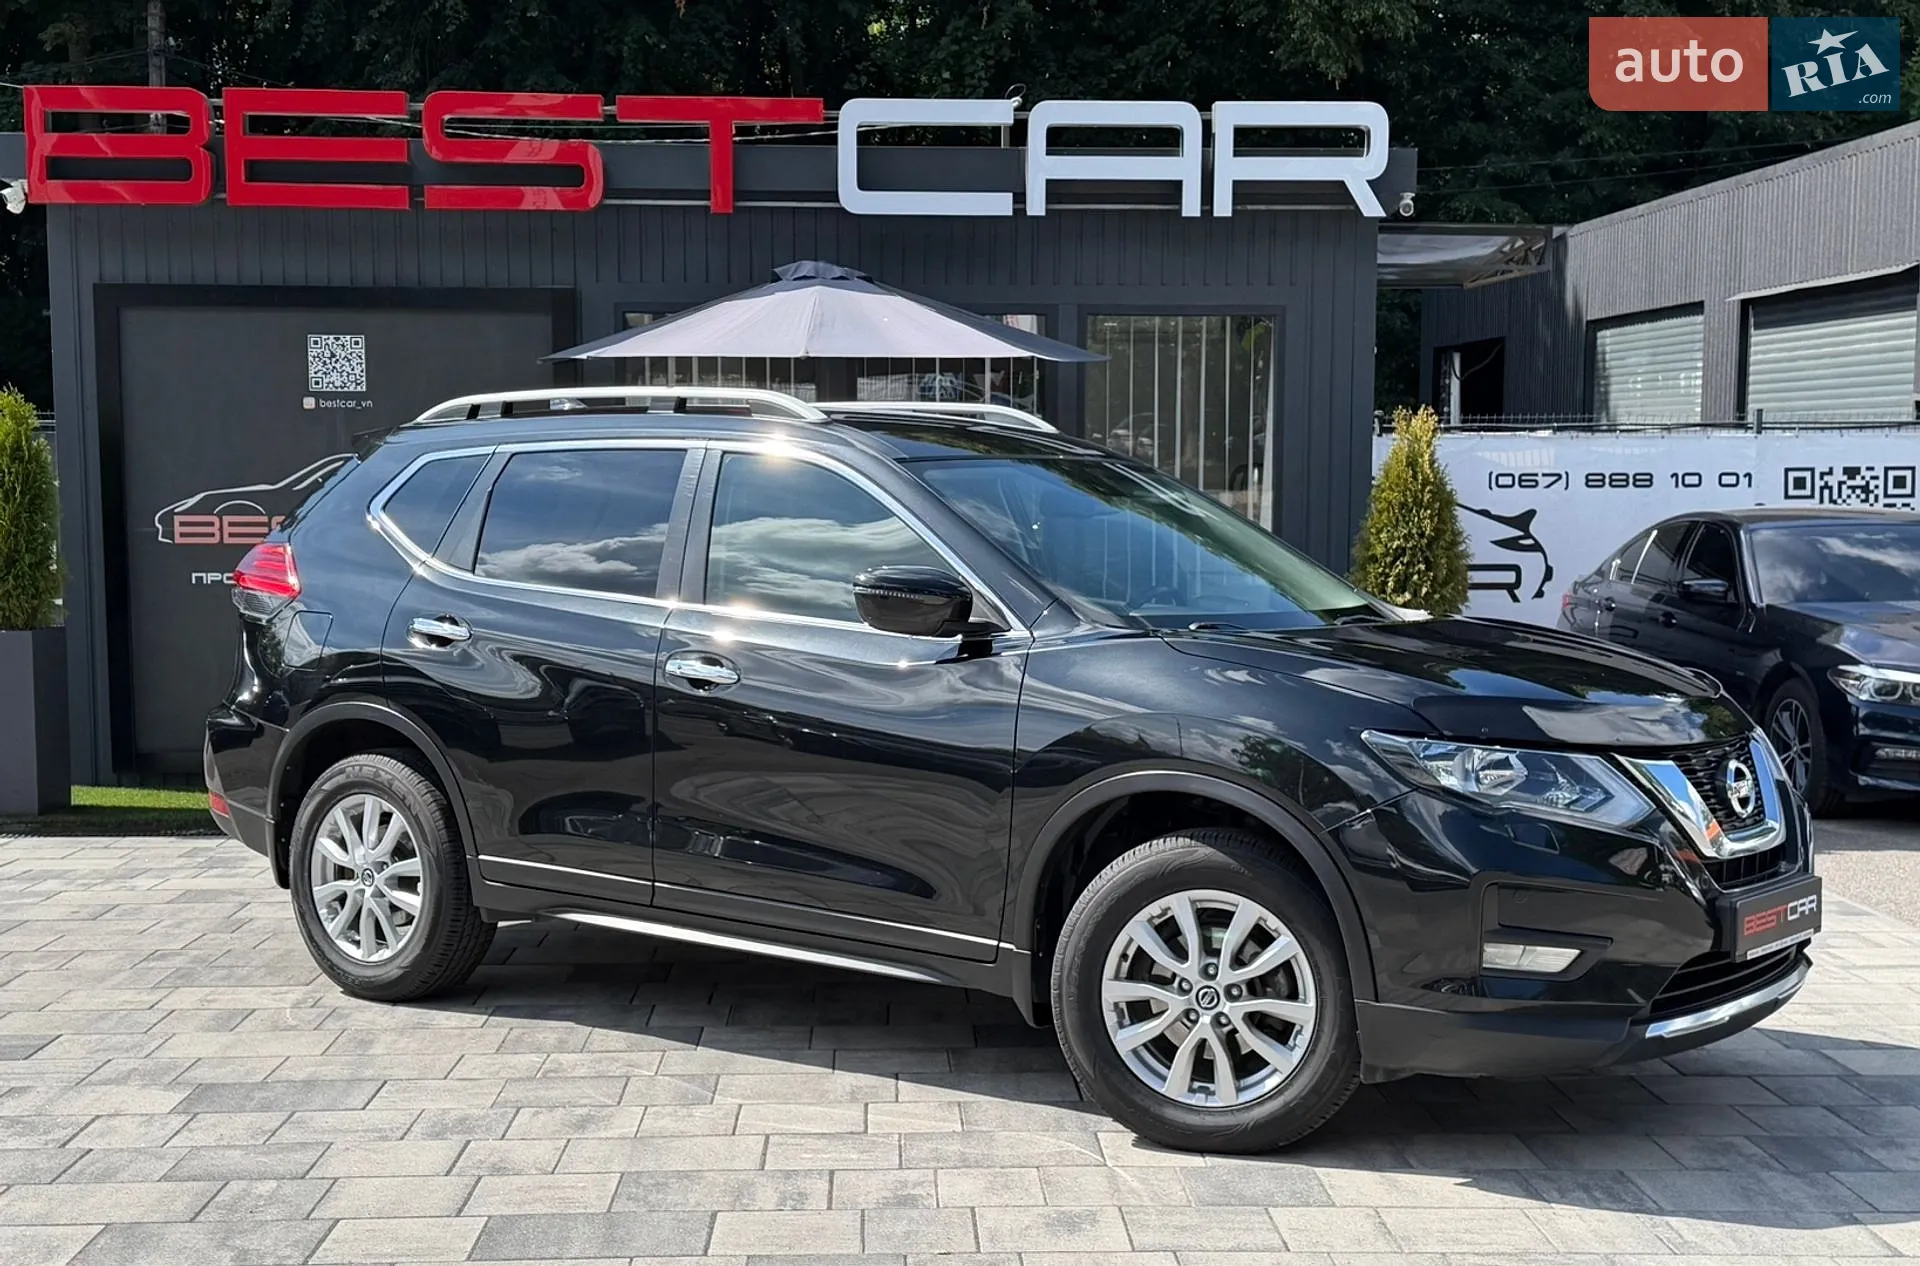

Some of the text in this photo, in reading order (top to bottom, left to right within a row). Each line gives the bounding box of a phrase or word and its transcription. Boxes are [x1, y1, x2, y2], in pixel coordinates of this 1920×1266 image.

[23, 85, 1390, 217] BEST CAR
[319, 398, 373, 410] bestcar_vn
[1488, 470, 1753, 491] (067) 888 10 01
